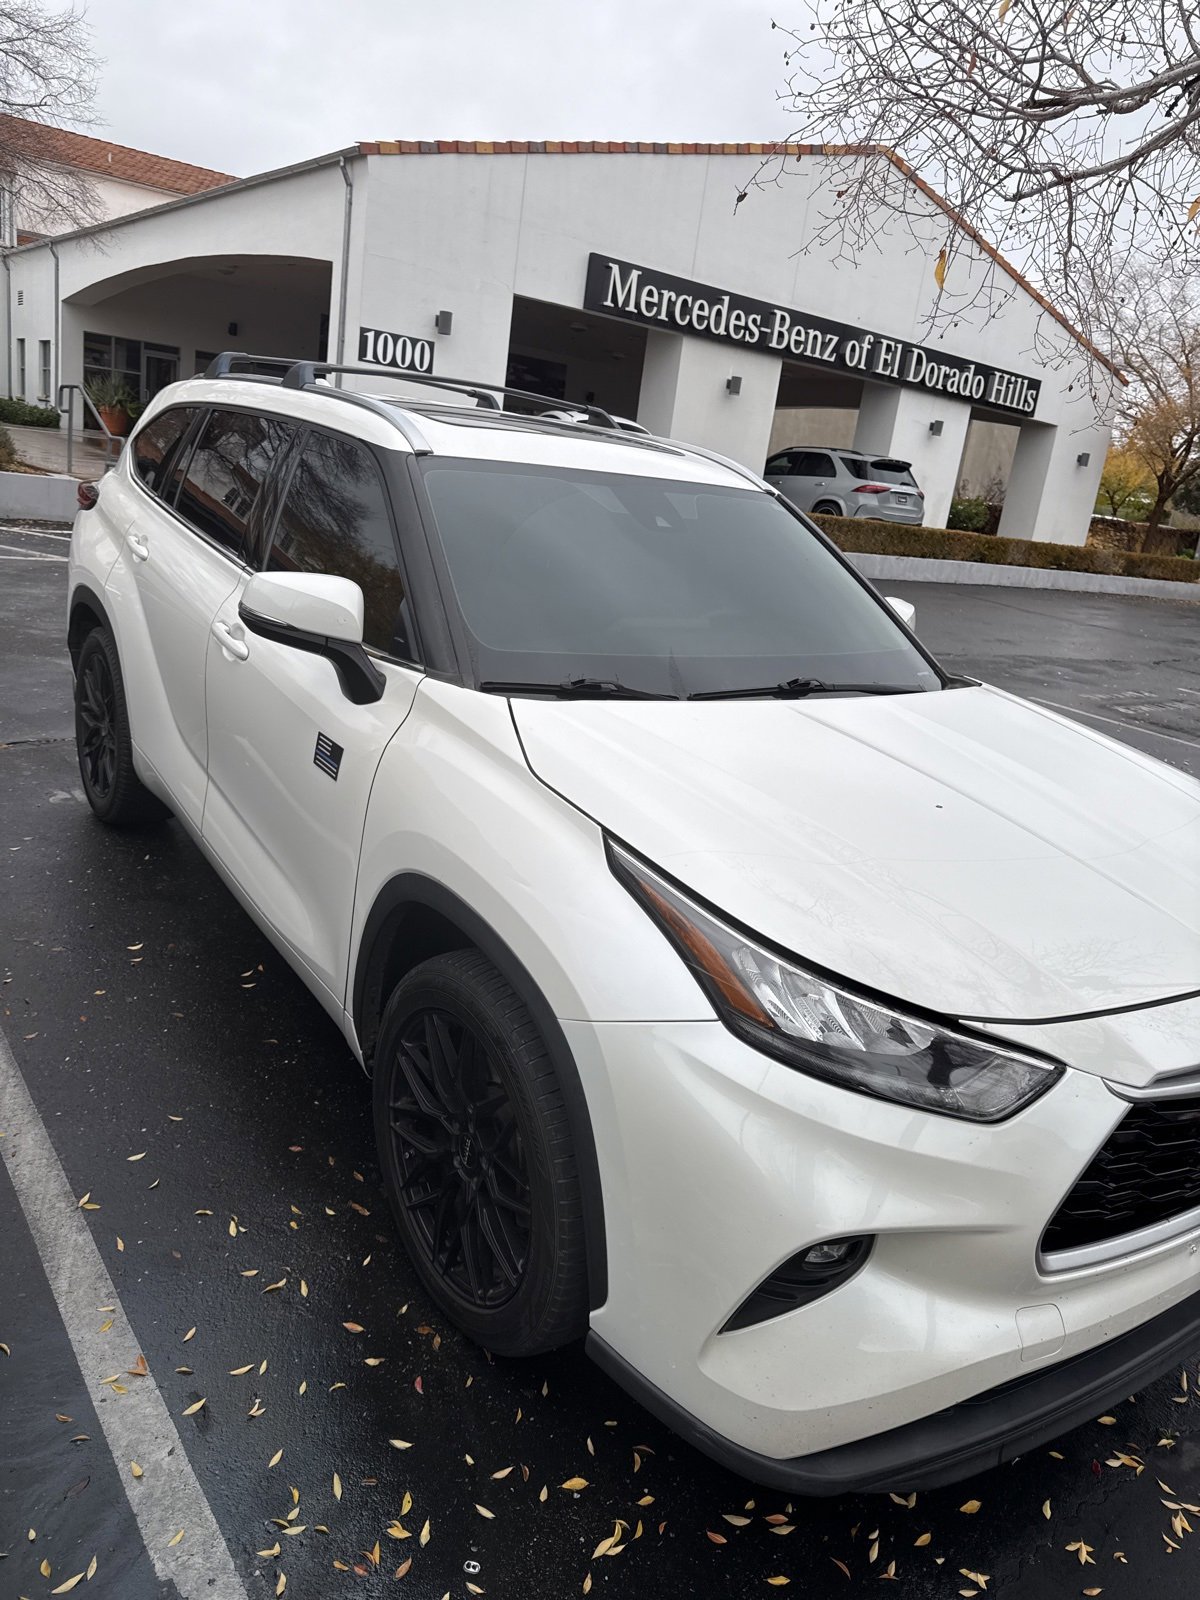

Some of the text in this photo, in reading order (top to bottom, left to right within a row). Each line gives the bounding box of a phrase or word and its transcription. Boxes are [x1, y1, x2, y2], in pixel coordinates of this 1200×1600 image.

[362, 330, 431, 372] 1000
[603, 262, 1037, 412] Mercedes-Benz of El Dorado Hills
